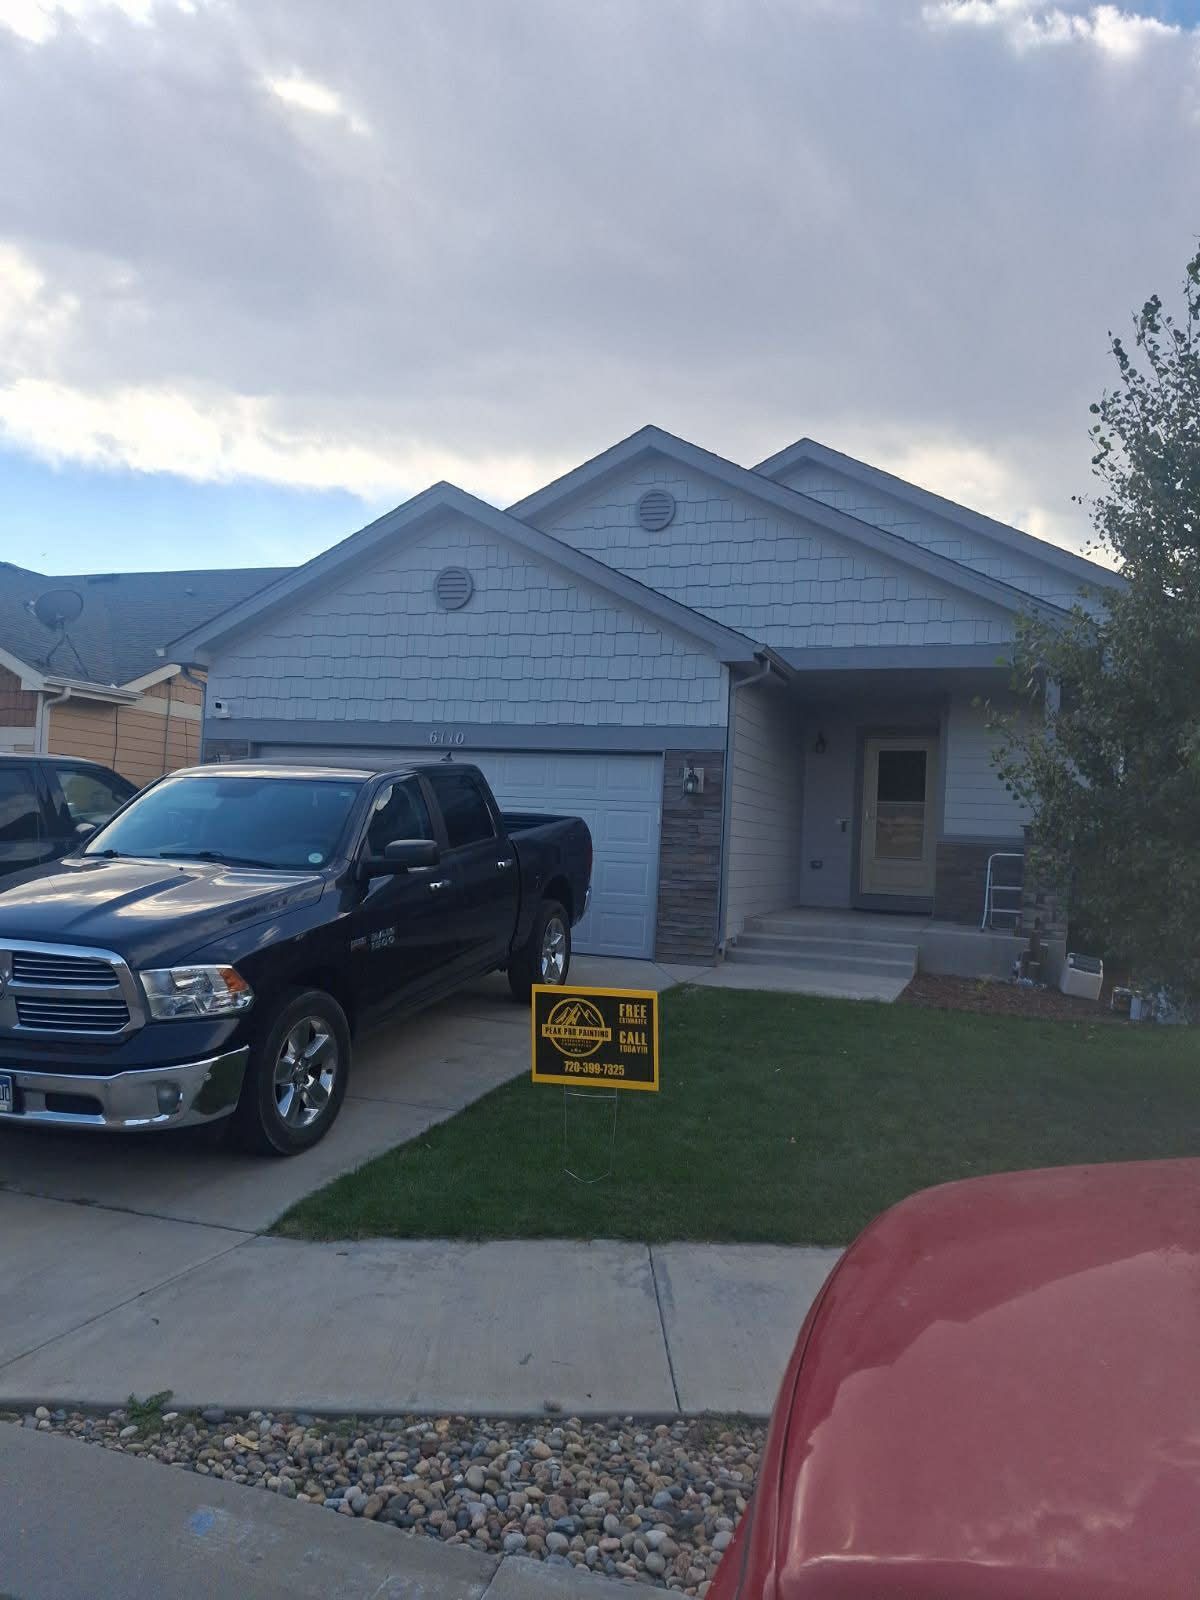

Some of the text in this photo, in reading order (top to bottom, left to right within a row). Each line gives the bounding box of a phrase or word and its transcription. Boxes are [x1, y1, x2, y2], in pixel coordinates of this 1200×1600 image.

[429, 730, 464, 745] 6110
[619, 1003, 647, 1019] FREE
[545, 1026, 609, 1038] PEAK PRO PAINTING
[619, 1030, 648, 1046] CALL
[563, 1060, 625, 1076] 720-399-7325
